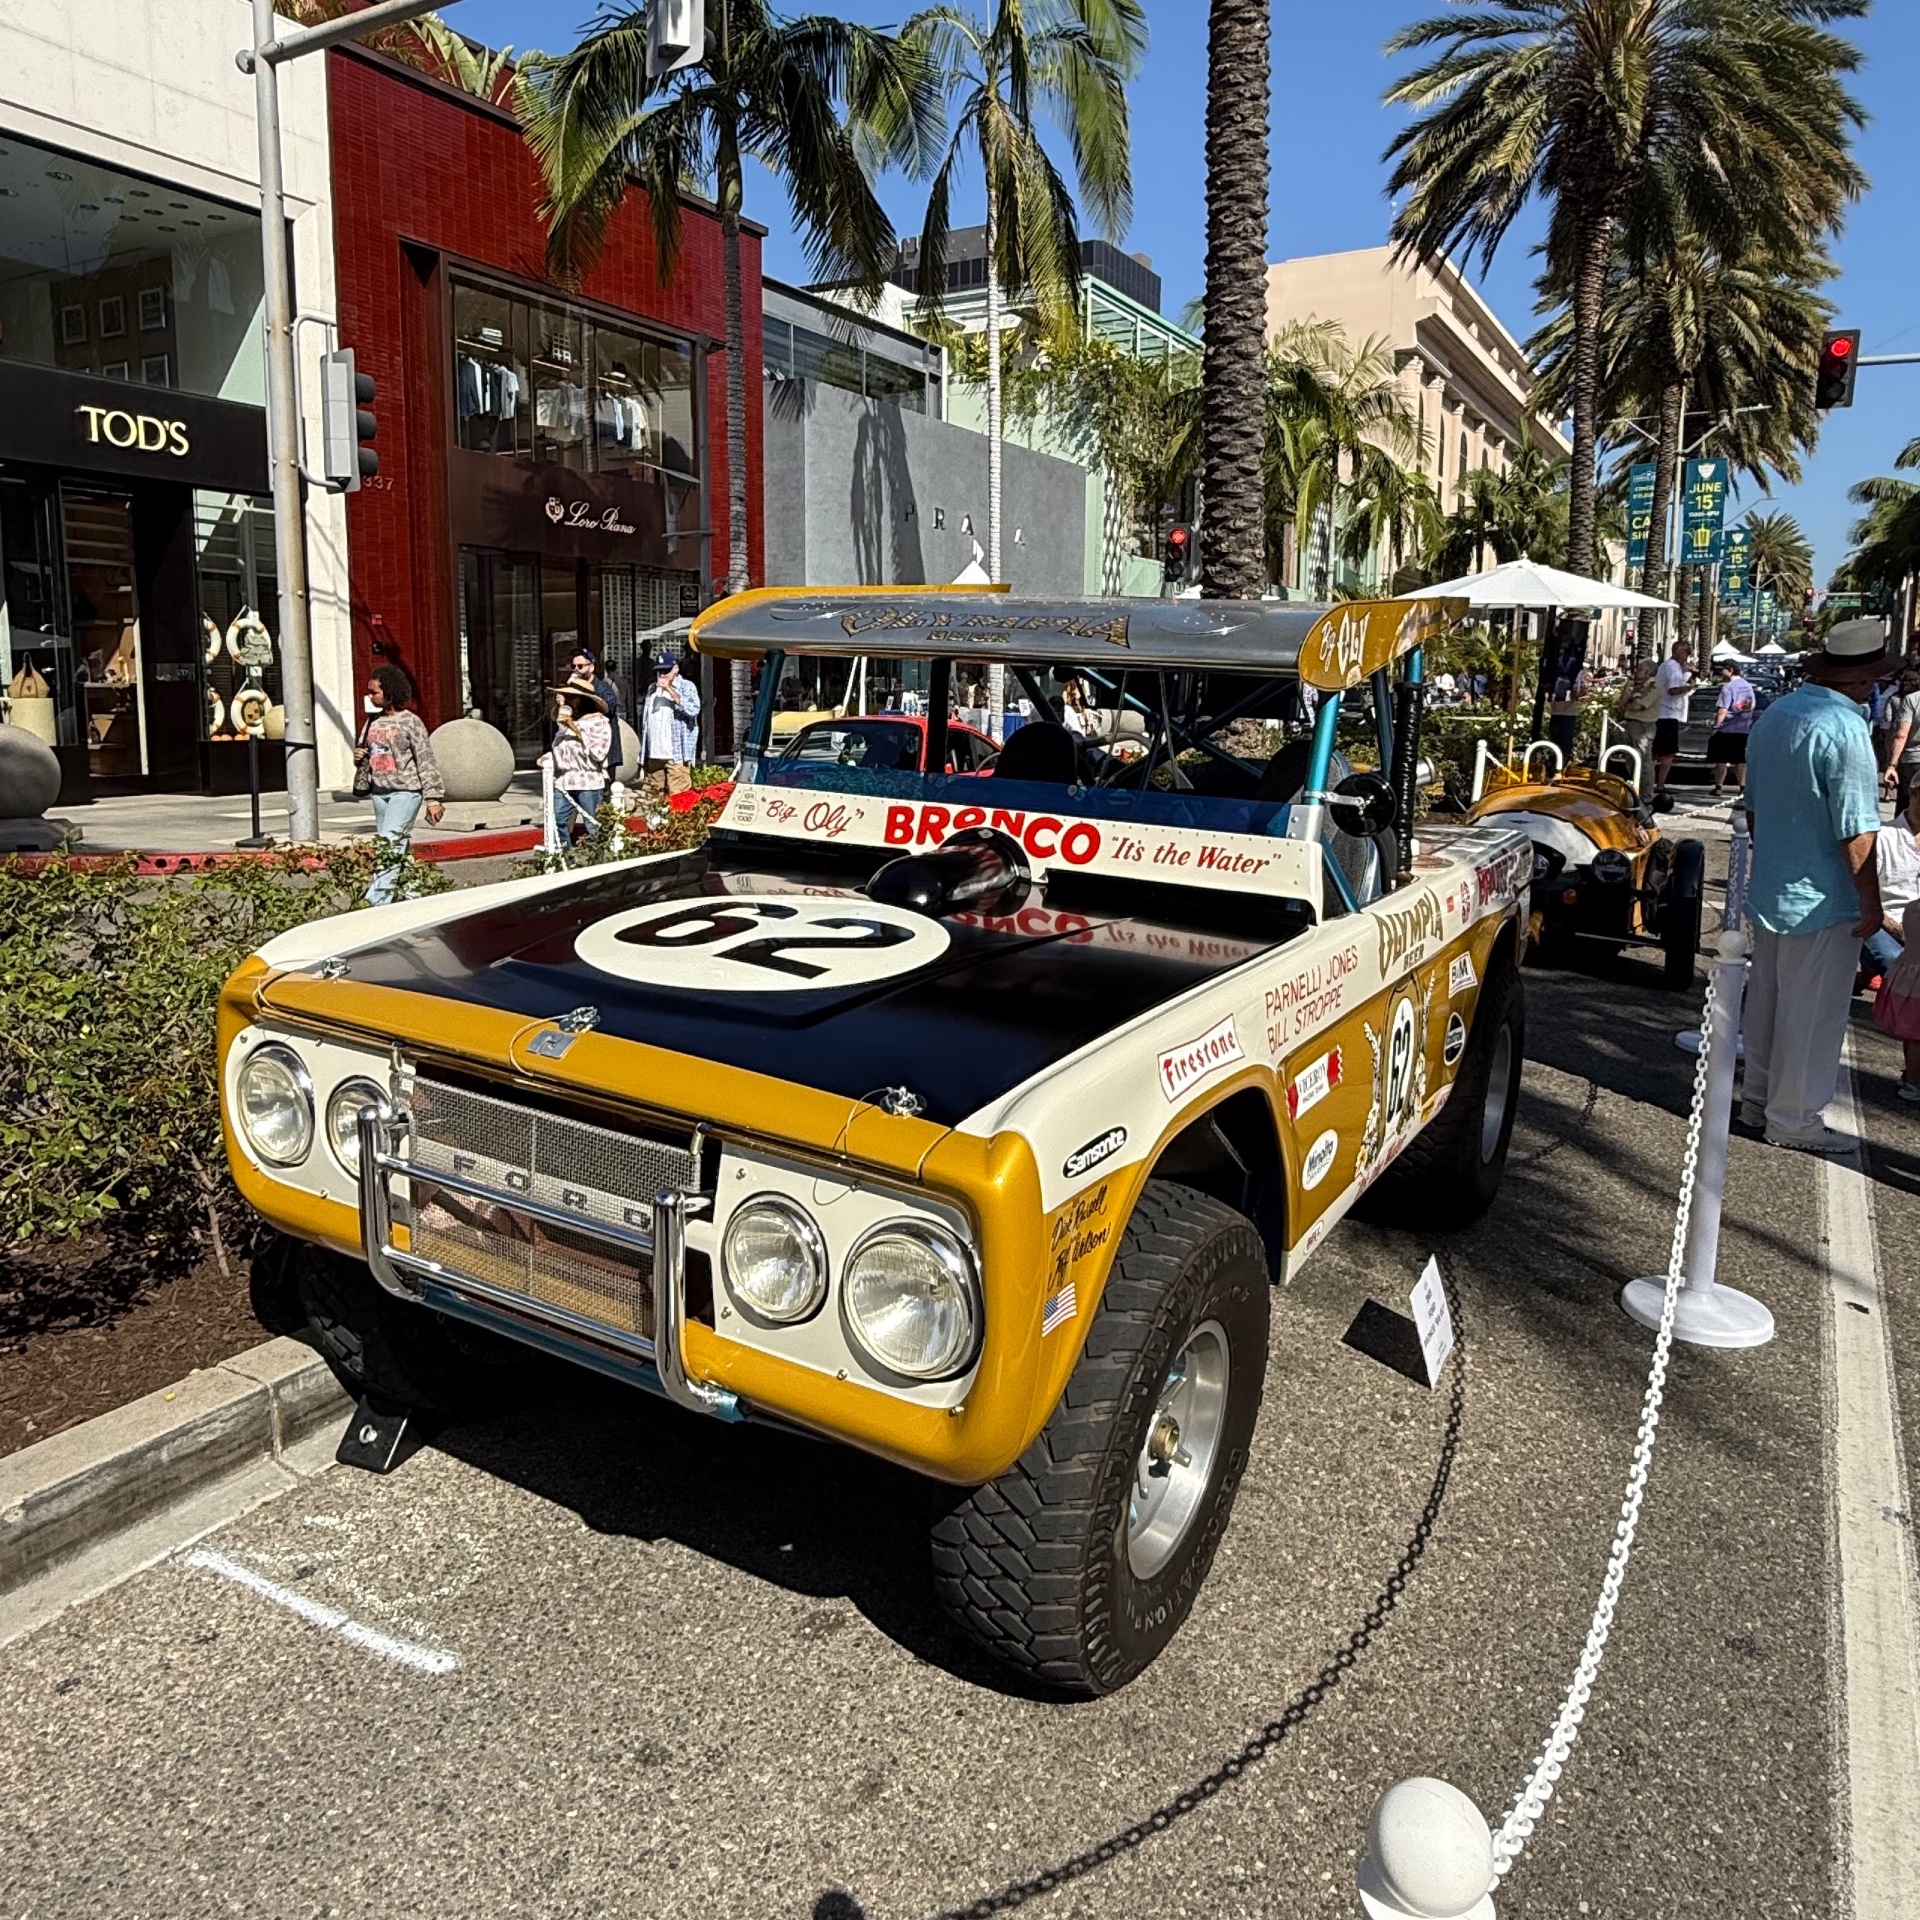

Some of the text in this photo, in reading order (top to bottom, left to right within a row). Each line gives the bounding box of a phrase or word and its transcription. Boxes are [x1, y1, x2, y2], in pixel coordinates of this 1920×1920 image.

[79, 405, 190, 457] TOD'S
[1688, 482, 1723, 493] JUNE
[564, 501, 637, 534] Loro Piana
[904, 503, 1026, 547] PRAA
[1632, 516, 1651, 530] CA
[1726, 545, 1749, 553] JUNE
[841, 606, 1130, 649] OLYMPIA
[926, 629, 1011, 643] BEER
[884, 806, 1101, 866] BRONCO
[1153, 842, 1191, 866] the
[614, 902, 916, 980] 62
[1371, 886, 1443, 981] OLYMPIA
[1402, 943, 1425, 973] BEER
[1265, 944, 1358, 1019] PARNELLI JONES
[1267, 983, 1343, 1055] BILL STROPPE
[1163, 1030, 1235, 1092] Firestone
[1387, 1019, 1411, 1123] 62
[1066, 1129, 1125, 1178] Samsonite
[453, 1154, 652, 1231] FORD
